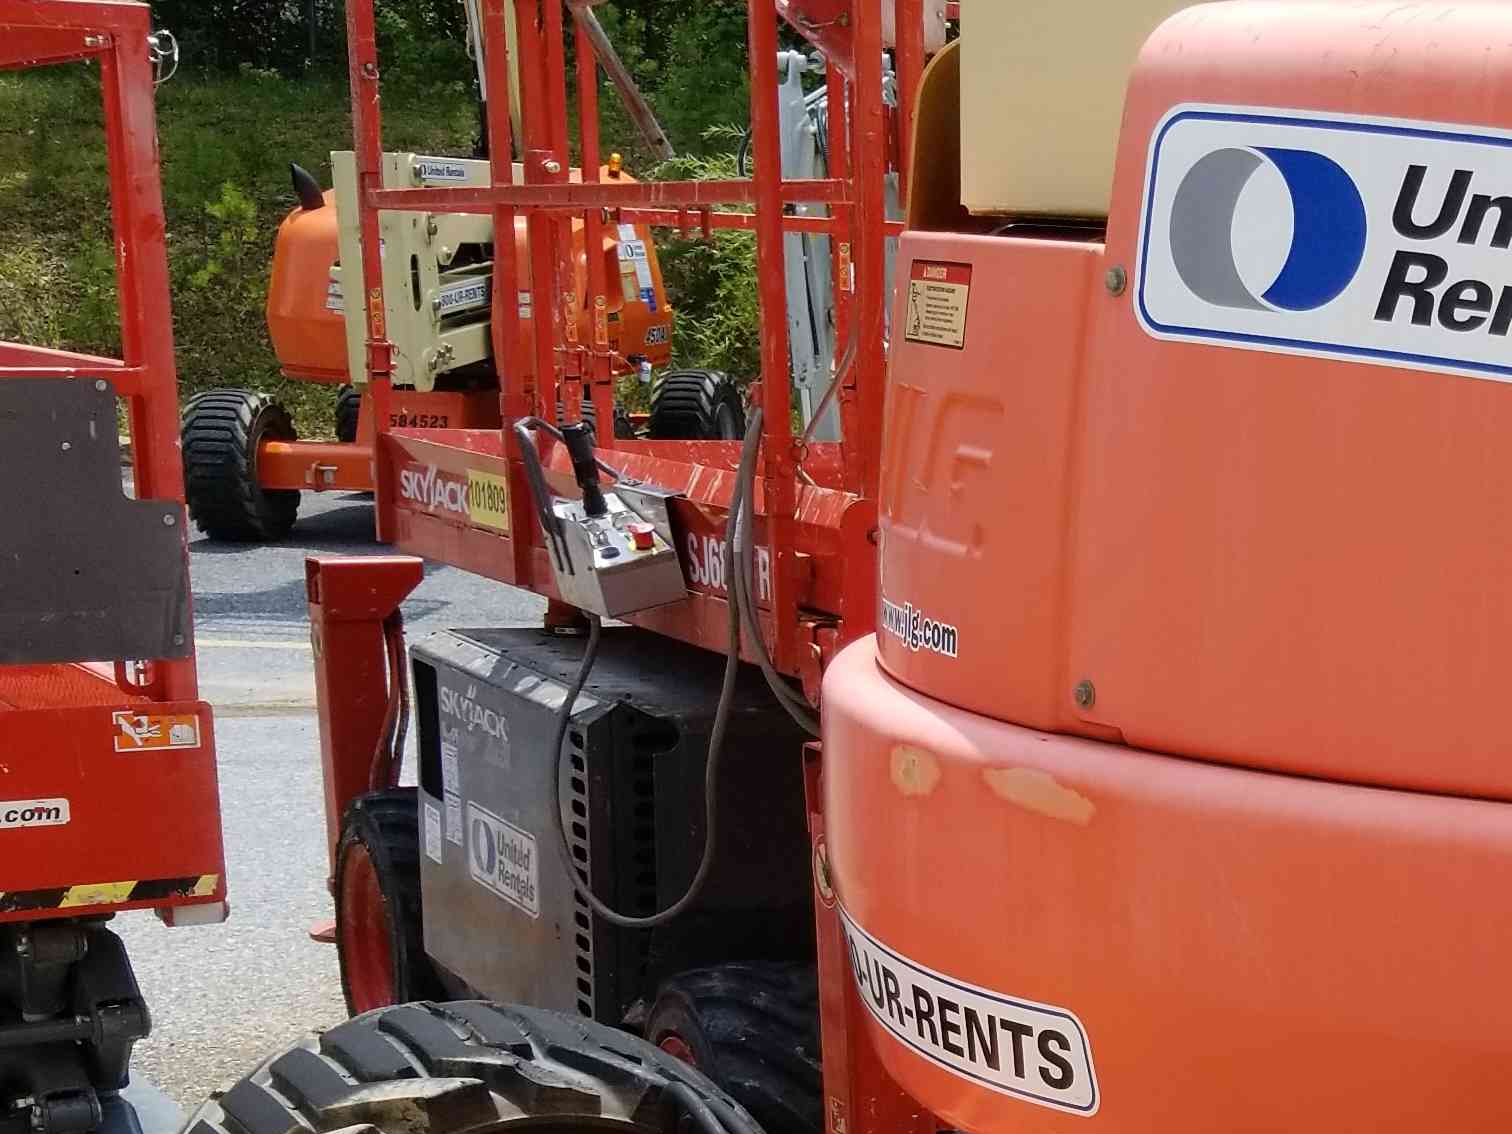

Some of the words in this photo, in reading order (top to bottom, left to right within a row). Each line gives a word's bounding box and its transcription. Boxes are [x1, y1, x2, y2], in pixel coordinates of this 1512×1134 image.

[400, 464, 471, 516] SKYJACK
[469, 479, 506, 515] 101809
[883, 600, 957, 656] www.jlg.com
[440, 684, 509, 743] SKYJACK
[496, 831, 531, 873] United
[497, 859, 536, 903] Rentals
